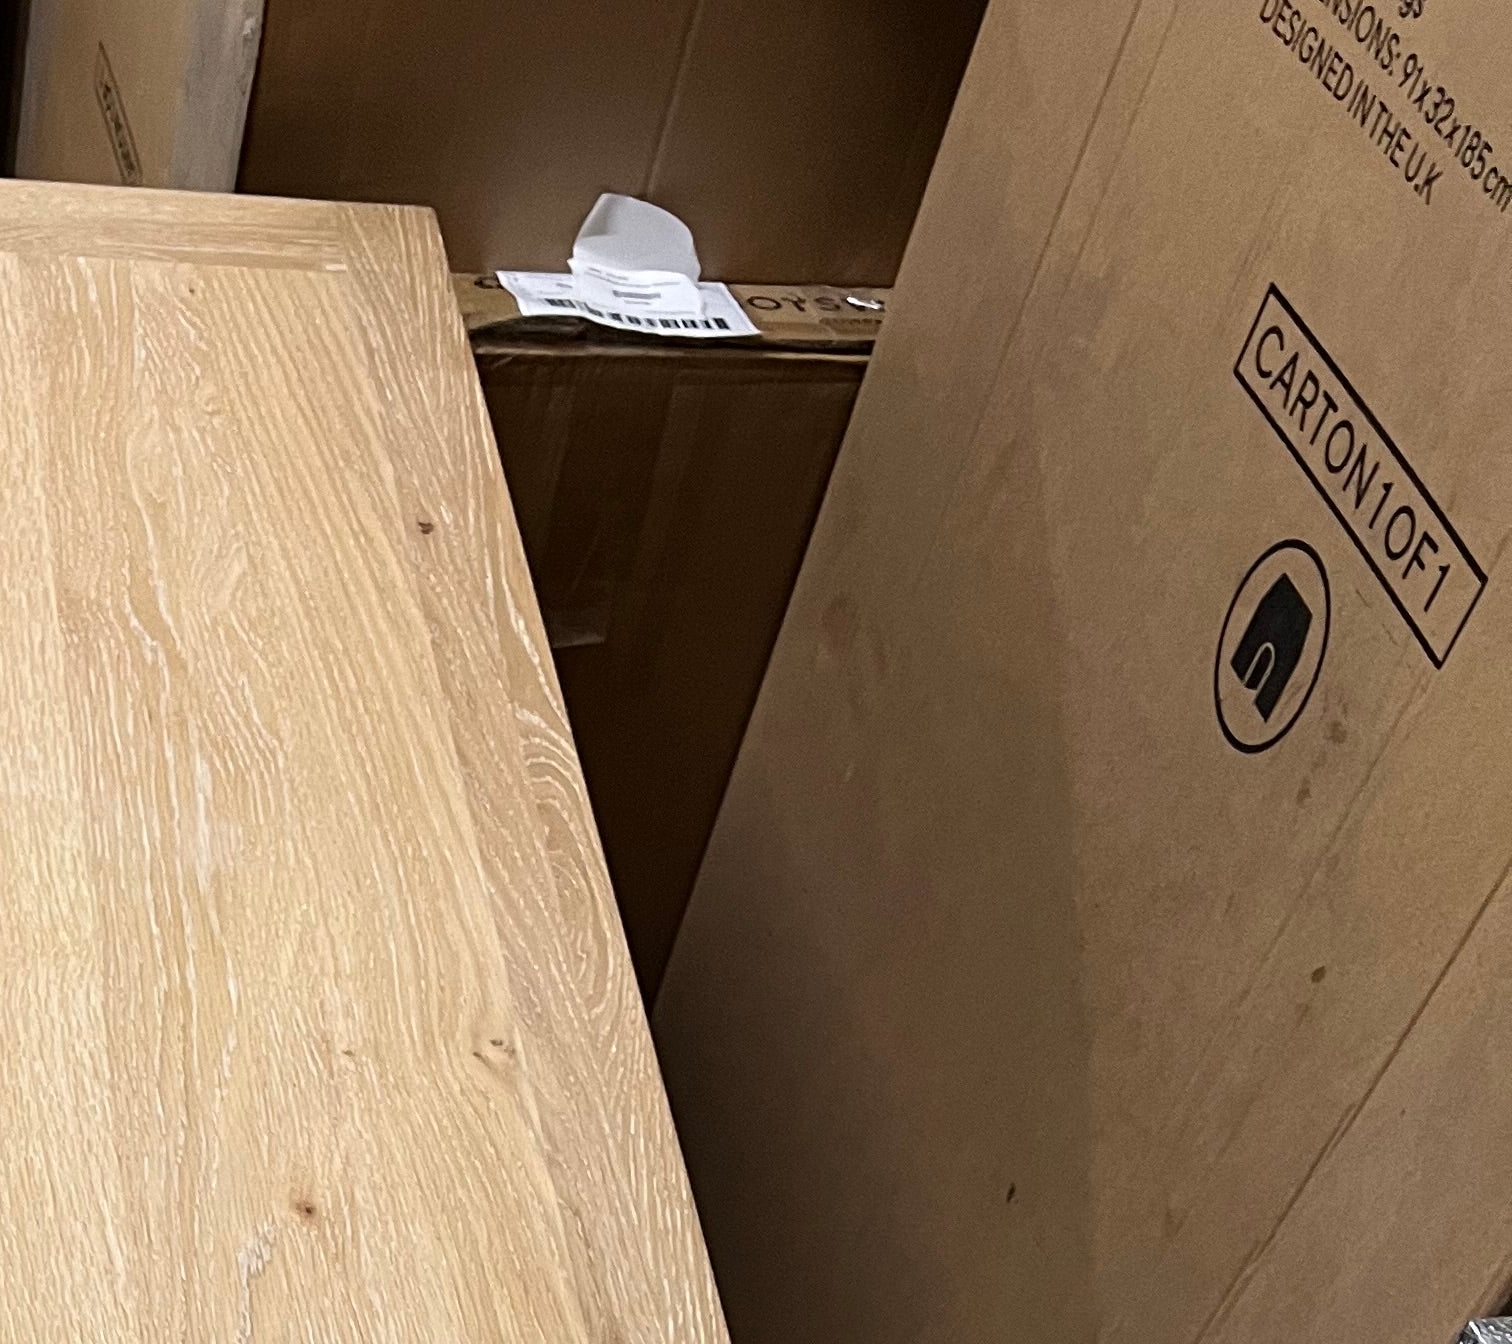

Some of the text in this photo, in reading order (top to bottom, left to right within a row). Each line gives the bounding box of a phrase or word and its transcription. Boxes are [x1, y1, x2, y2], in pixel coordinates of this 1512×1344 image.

[1259, 0, 1354, 101] DESIGNED
[1347, 78, 1377, 128] IN
[1369, 100, 1412, 168] THE
[1255, 325, 1451, 613] CARTON 1 OF 1
